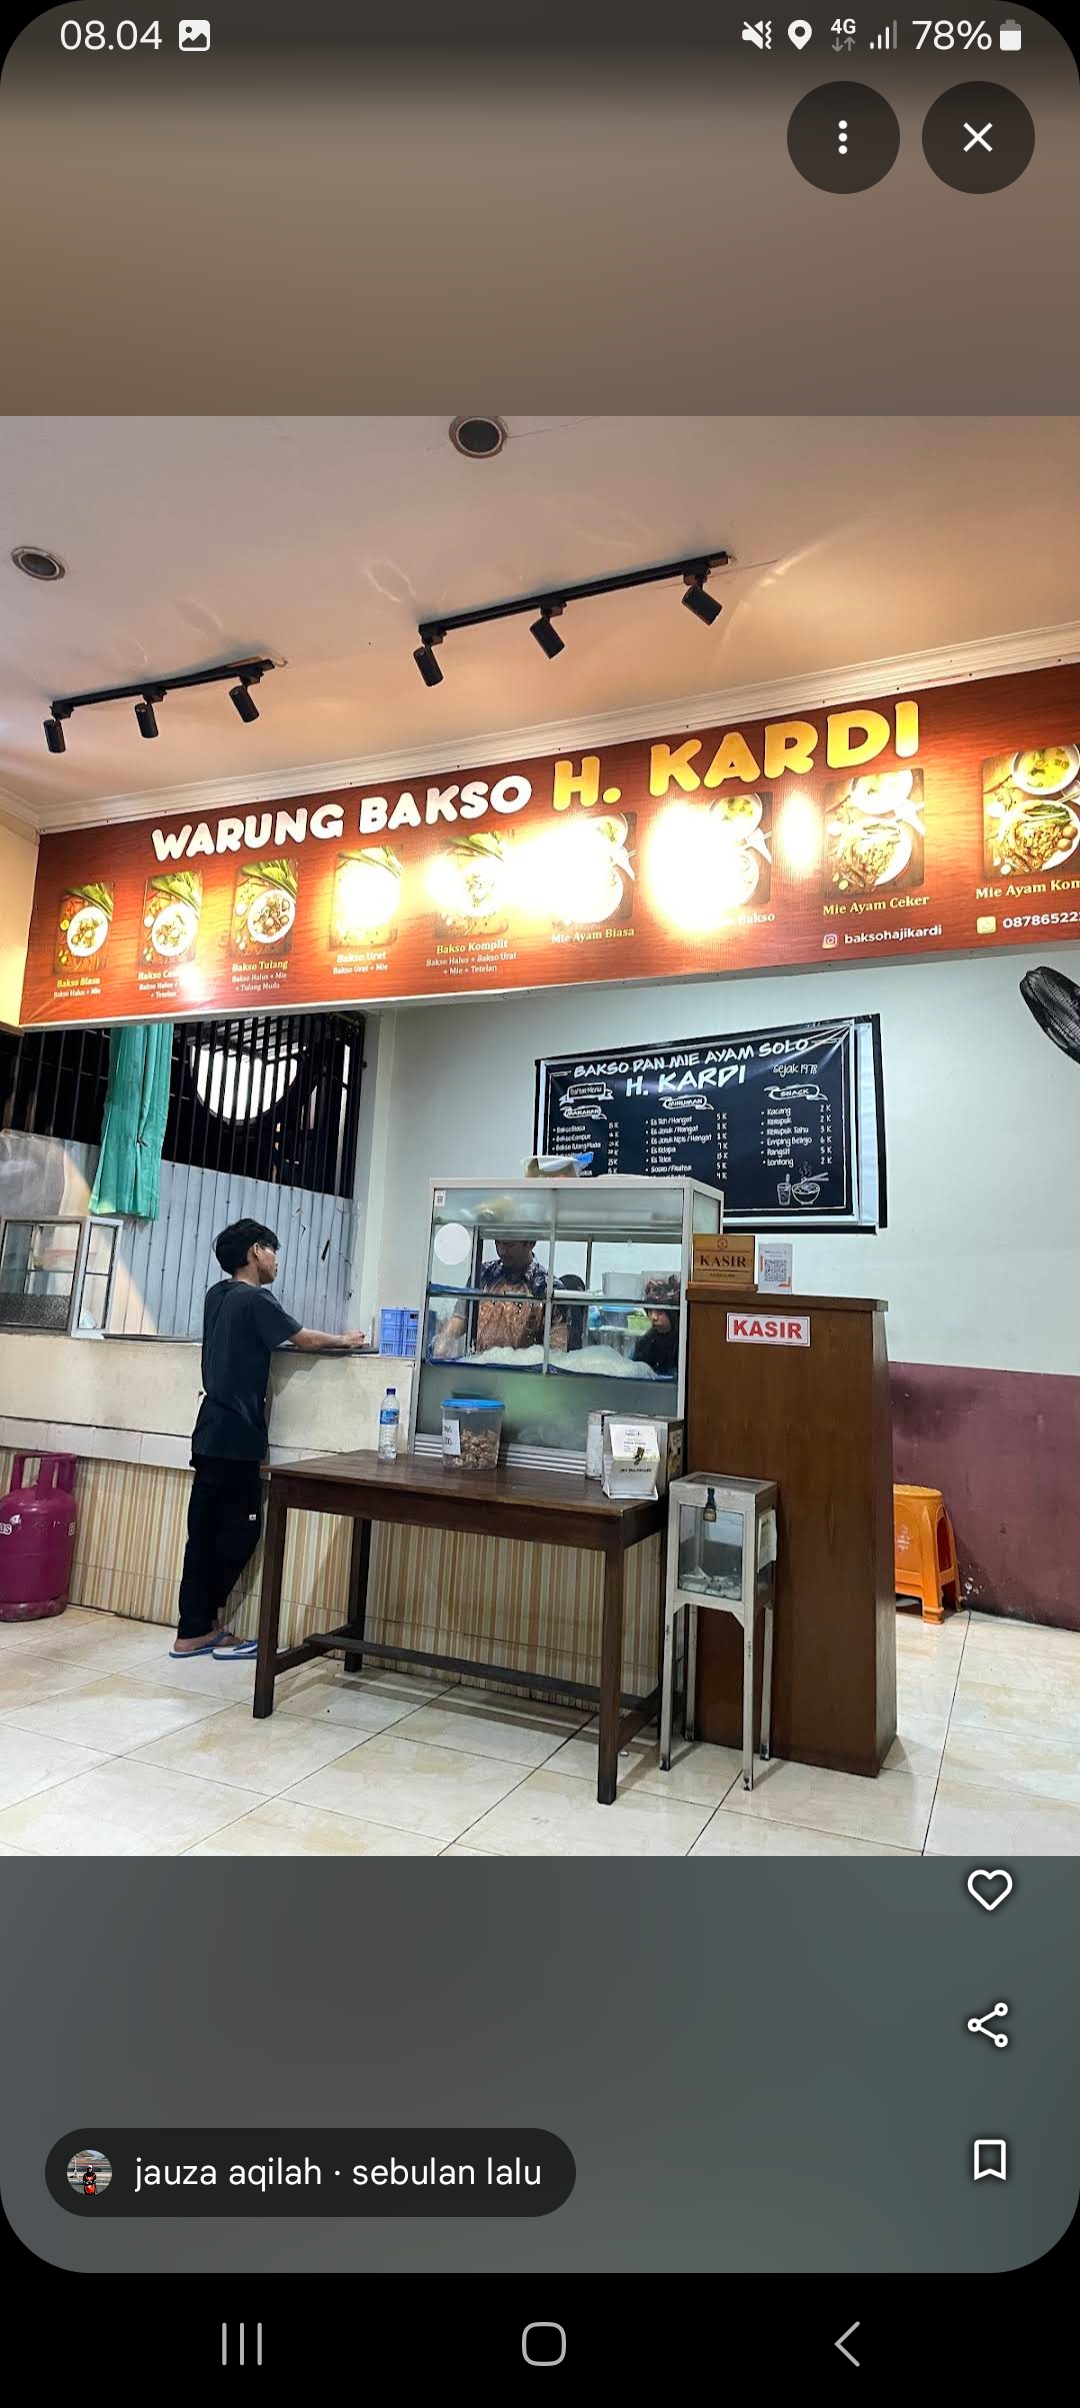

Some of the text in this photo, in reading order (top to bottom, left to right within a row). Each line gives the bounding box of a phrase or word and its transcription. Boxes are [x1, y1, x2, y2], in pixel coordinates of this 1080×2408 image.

[151, 700, 919, 861] WARUNG BAKSO H. KARDI
[976, 887, 1002, 899] Mie
[1005, 883, 1046, 898] Ayam
[823, 896, 930, 915] Mie Ayam Ceker
[551, 927, 635, 943] Mie Ayam Biasa
[844, 924, 943, 944] baksohajikardi
[436, 939, 508, 954] Bakso Komplit
[232, 960, 288, 972] Bakso Tulang
[426, 958, 447, 966] Bakso
[449, 956, 469, 965] Halus
[477, 954, 499, 962] Bakso
[500, 952, 517, 960] Urat
[574, 1039, 809, 1079] BAKSO DAN MIE AYAM SOLO
[773, 1063, 798, 1077] sejak
[625, 1065, 746, 1097] H. KARDI
[780, 1088, 809, 1097] SNACK
[767, 1107, 791, 1116] Kacang
[767, 1158, 793, 1168] Lontong
[700, 1254, 746, 1268] KASIR
[733, 1320, 802, 1339] KASIR
